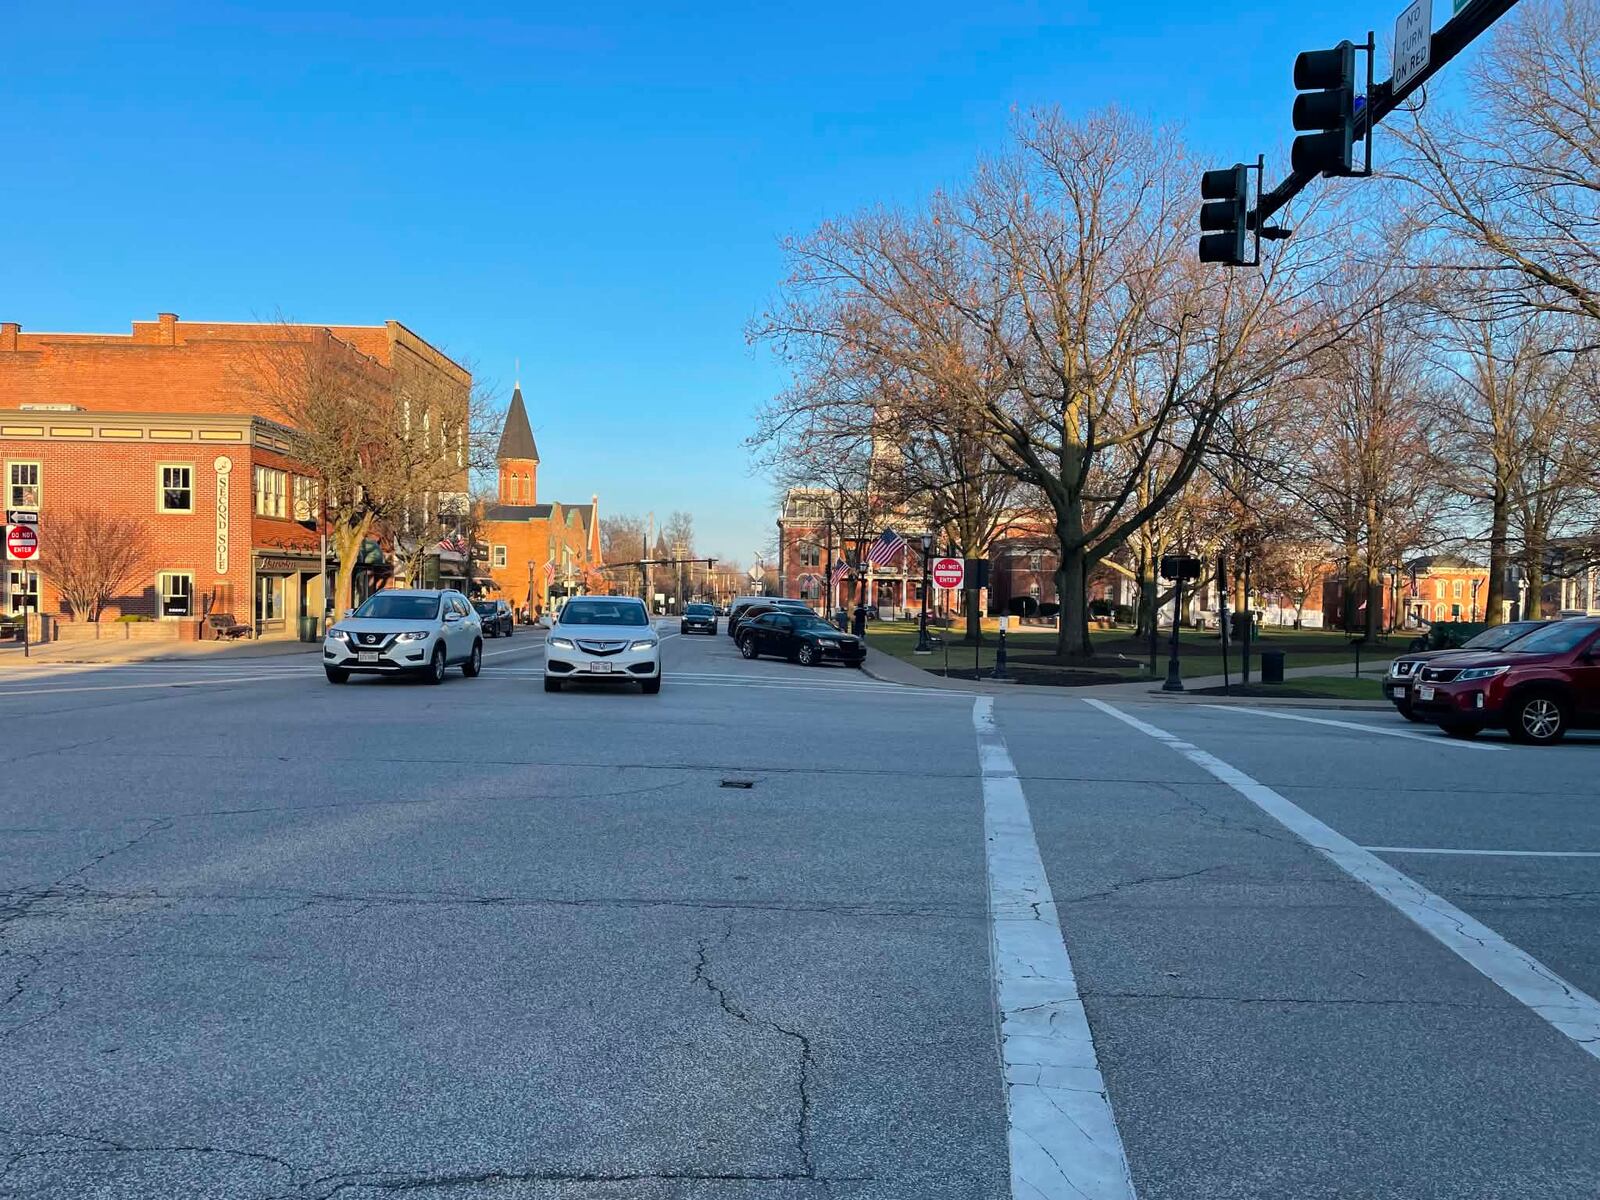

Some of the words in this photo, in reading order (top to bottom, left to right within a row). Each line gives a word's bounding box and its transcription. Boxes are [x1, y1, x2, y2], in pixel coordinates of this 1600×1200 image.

[1406, 6, 1421, 29] NO
[1402, 25, 1424, 55] TURN
[1395, 62, 1407, 83] ON
[1410, 46, 1427, 73] RED
[218, 477, 227, 529] SECOND
[217, 533, 227, 570] SOLE
